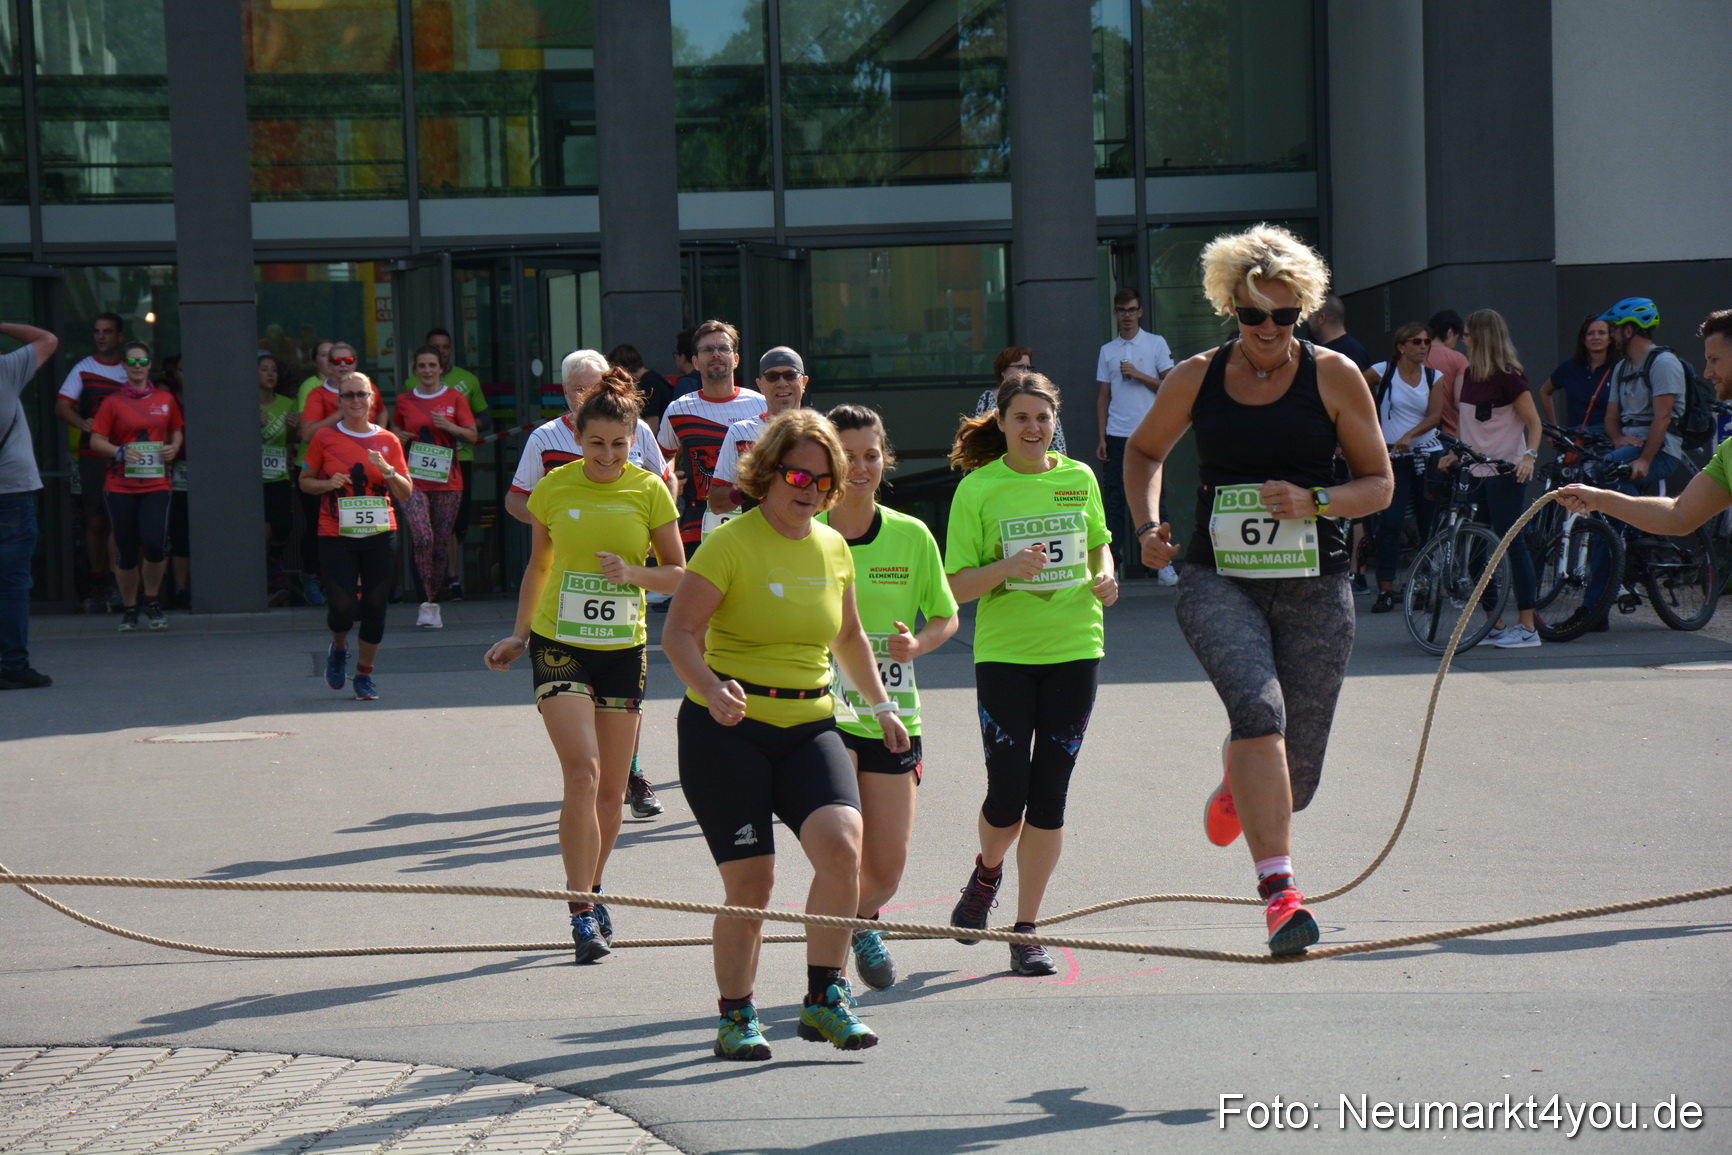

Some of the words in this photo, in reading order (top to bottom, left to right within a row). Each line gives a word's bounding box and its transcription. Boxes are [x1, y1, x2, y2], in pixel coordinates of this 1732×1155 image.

[413, 444, 448, 457] BOCK
[263, 457, 278, 468] 00
[421, 456, 437, 469] 54
[343, 499, 383, 508] BOCK
[355, 511, 374, 524] 55
[1008, 516, 1079, 538] BOCK
[1241, 518, 1280, 545] 67
[1224, 553, 1307, 564] ANNA-MARIA
[1023, 569, 1074, 583] ANDRA
[568, 575, 634, 594] BOCK
[583, 599, 616, 621] 66
[580, 626, 614, 637] ELISA
